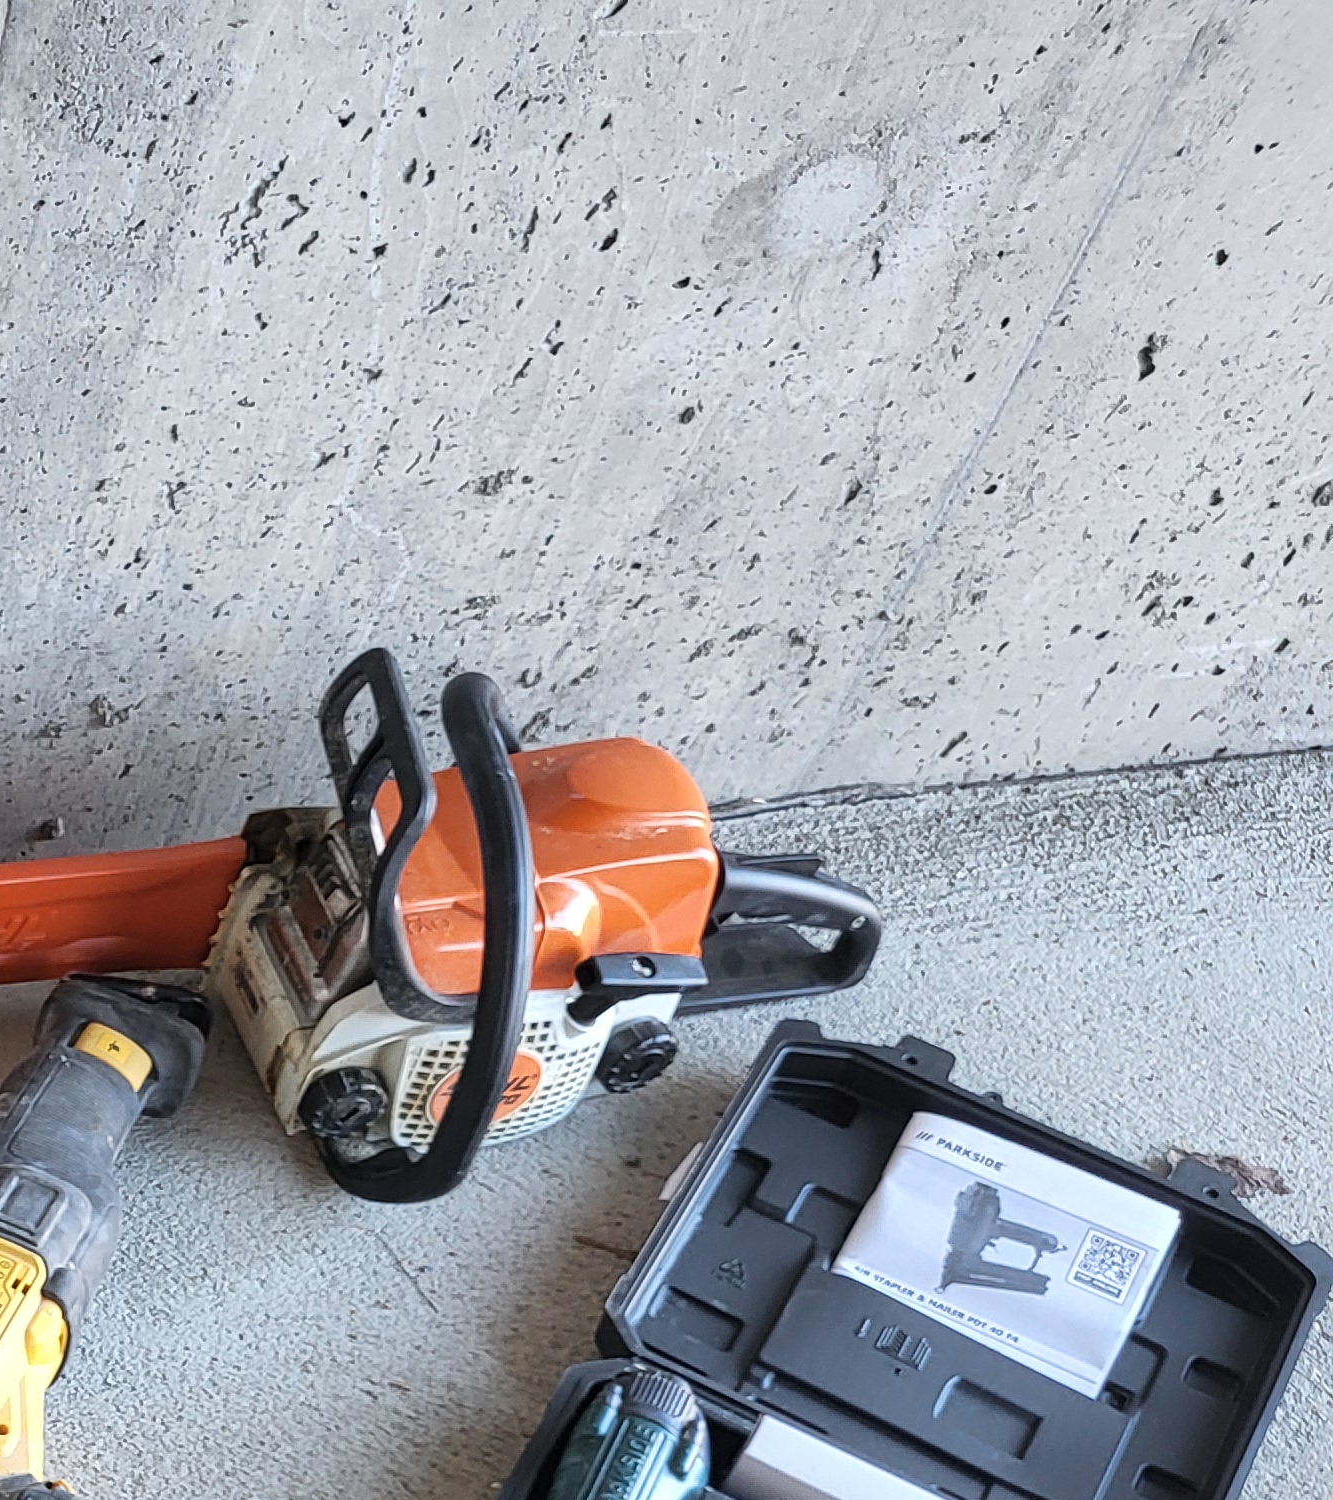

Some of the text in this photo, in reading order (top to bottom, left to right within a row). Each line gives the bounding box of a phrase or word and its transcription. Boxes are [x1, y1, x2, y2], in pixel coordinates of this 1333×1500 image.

[936, 1138, 1004, 1172] PARKSIDE
[874, 1272, 915, 1297] STAPLER
[928, 1299, 965, 1319] NAILER
